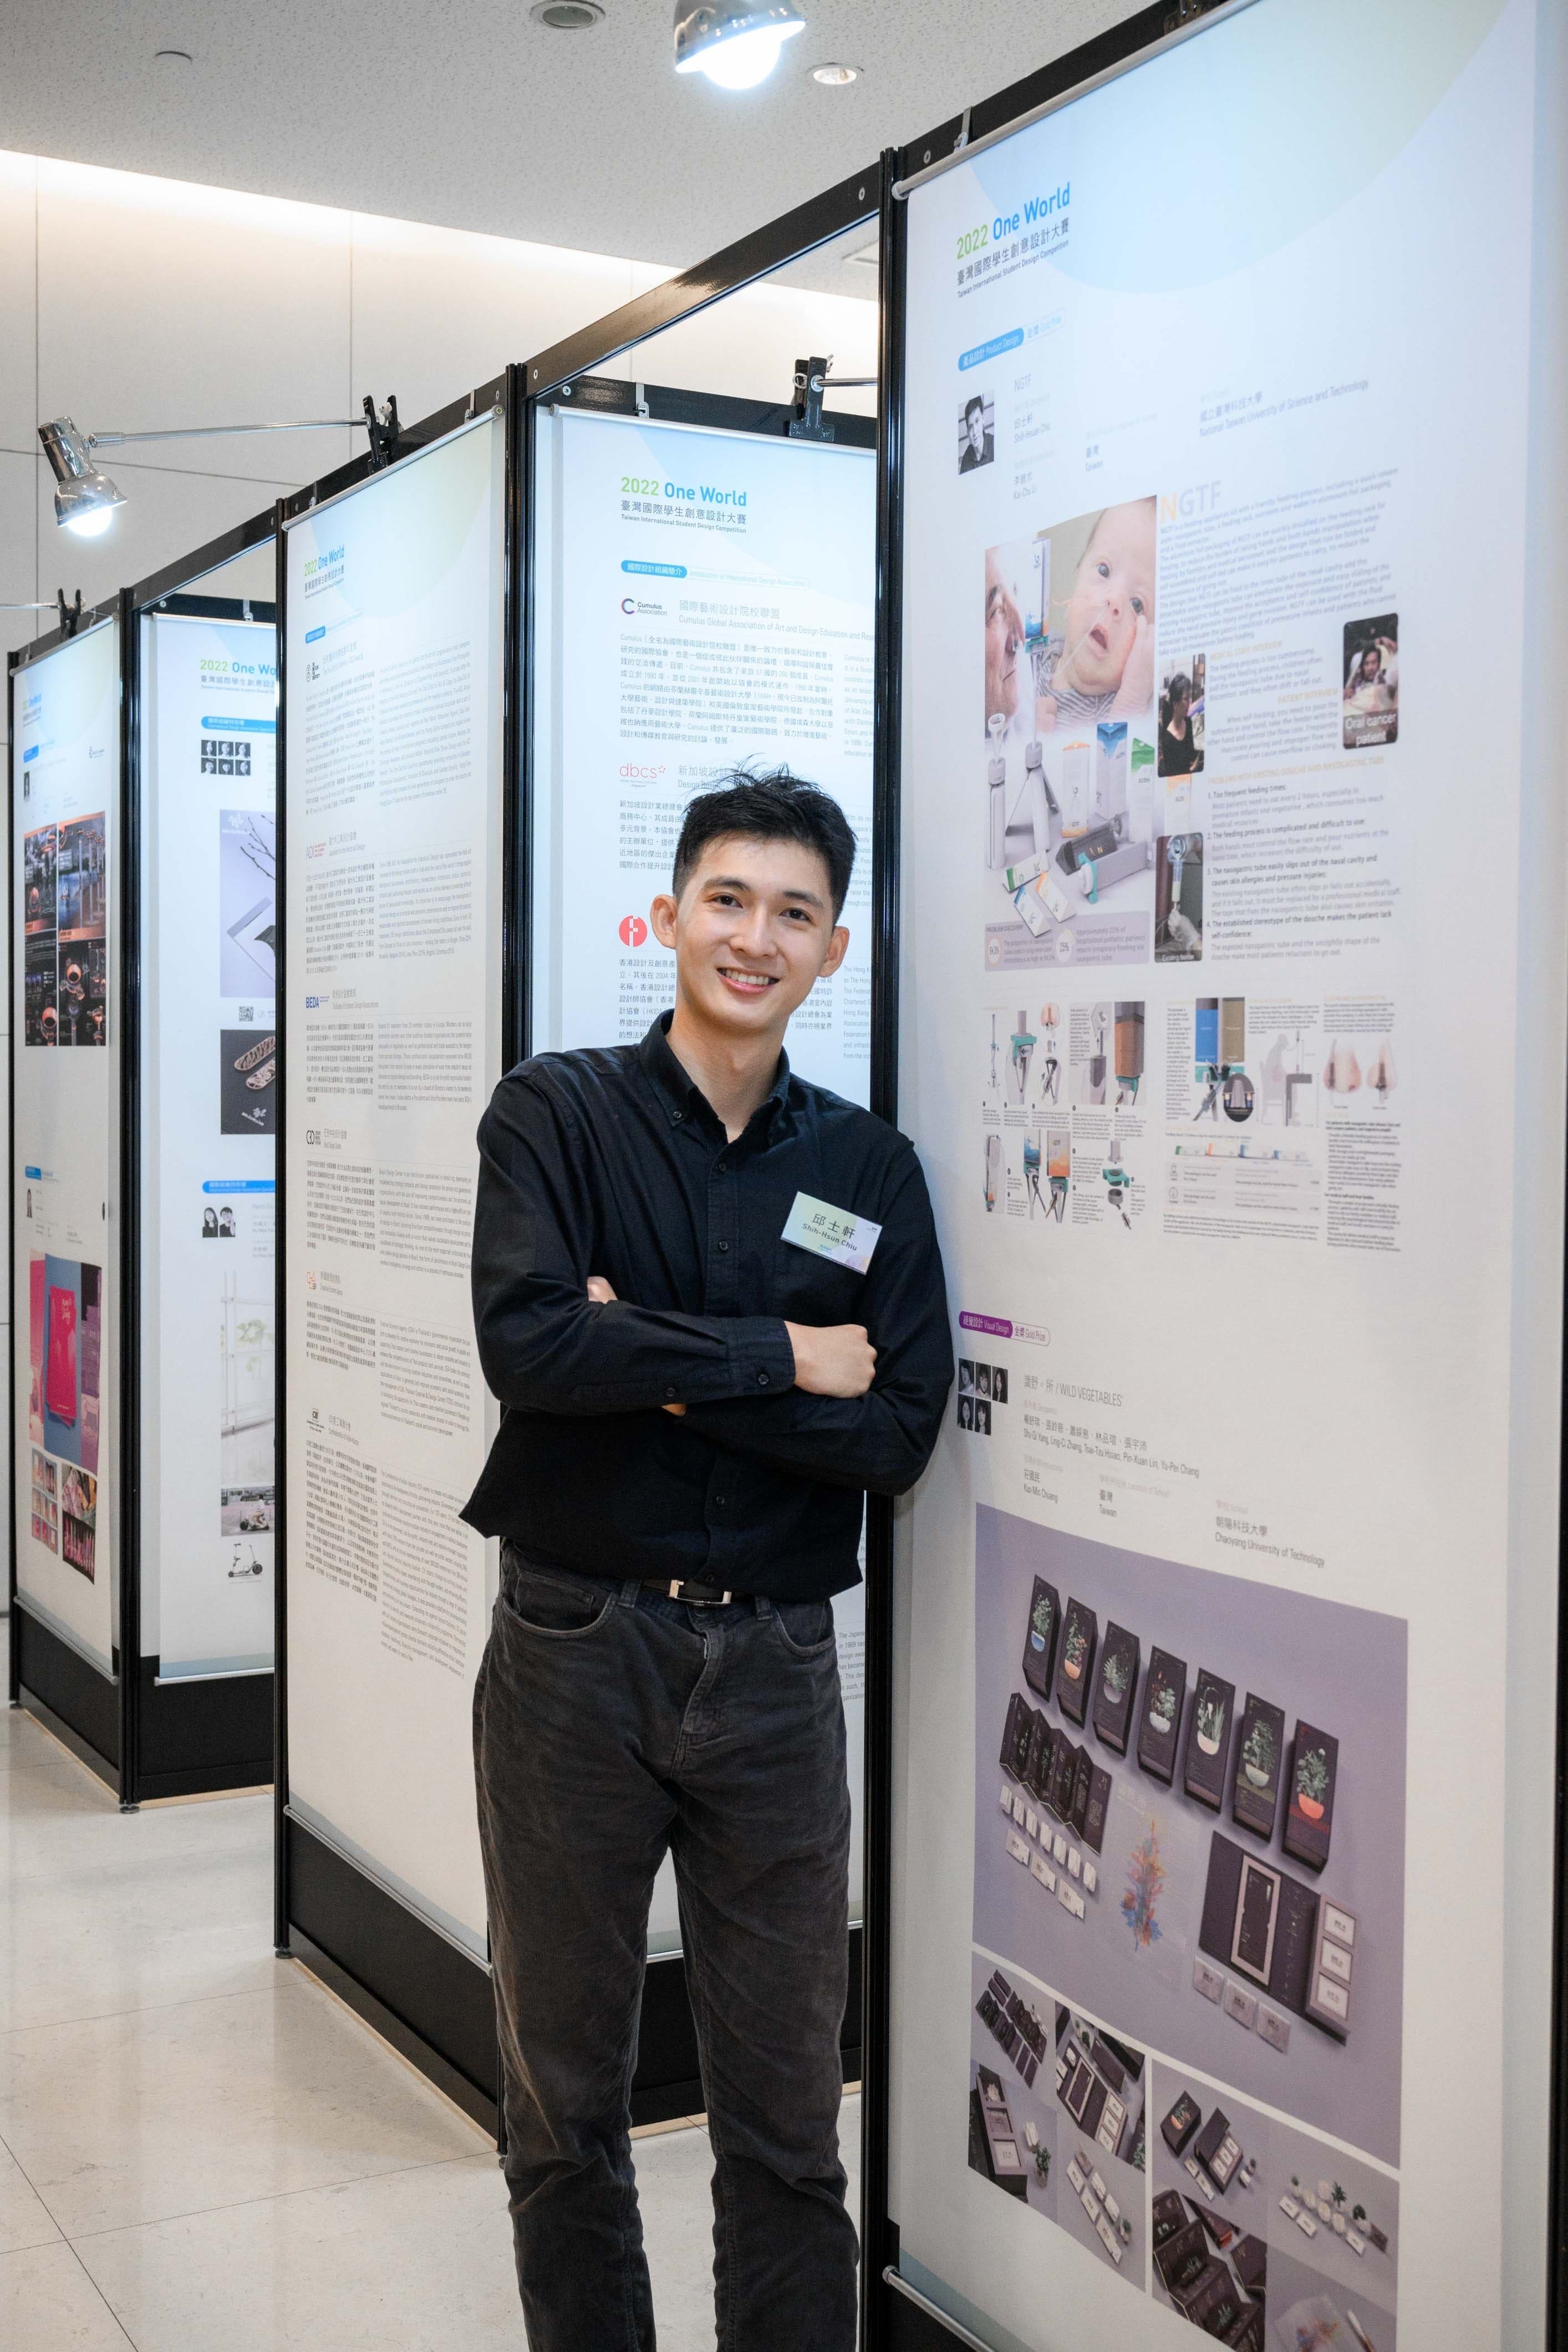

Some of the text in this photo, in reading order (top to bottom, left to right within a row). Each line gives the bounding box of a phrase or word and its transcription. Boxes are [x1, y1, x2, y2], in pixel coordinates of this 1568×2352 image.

[957, 182, 1070, 259] 2022 One World
[958, 217, 1069, 286] 臺灣國際學生創意設計大賽
[958, 240, 1069, 298] Taiwan International Student Design Competition
[1002, 335, 1020, 349] Design
[1015, 374, 1032, 391] NGTF
[621, 477, 746, 507] 2022 One World
[621, 500, 746, 525] 臺灣國際學生創意設計大賽
[641, 516, 675, 526] International
[715, 525, 746, 533] Competition
[304, 544, 344, 577] 2022 One World
[637, 602, 662, 610] Cumulus
[637, 608, 667, 617] Association
[679, 599, 780, 619] 國際藝術設計院校聯盟
[679, 614, 705, 625] Cumulus
[707, 617, 727, 627] Global
[729, 620, 765, 630] Association
[799, 626, 818, 637] Design
[820, 628, 848, 638] Education
[200, 659, 228, 672] 2022
[232, 662, 254, 674] One
[619, 762, 657, 778] dbcs
[678, 780, 699, 790] Design
[306, 996, 319, 1008] BEDA
[812, 1213, 856, 1240] 邱士軒
[841, 1240, 857, 1251] Chiu
[984, 1320, 995, 1331] Visual
[996, 1322, 1009, 1335] Design
[1026, 1328, 1035, 1339] Gold
[1036, 1331, 1046, 1341] Prize
[1060, 1382, 1076, 1398] WILD
[1099, 1504, 1117, 1517] Taiwan
[1215, 1531, 1325, 1569] Chaoyang University of Technology
